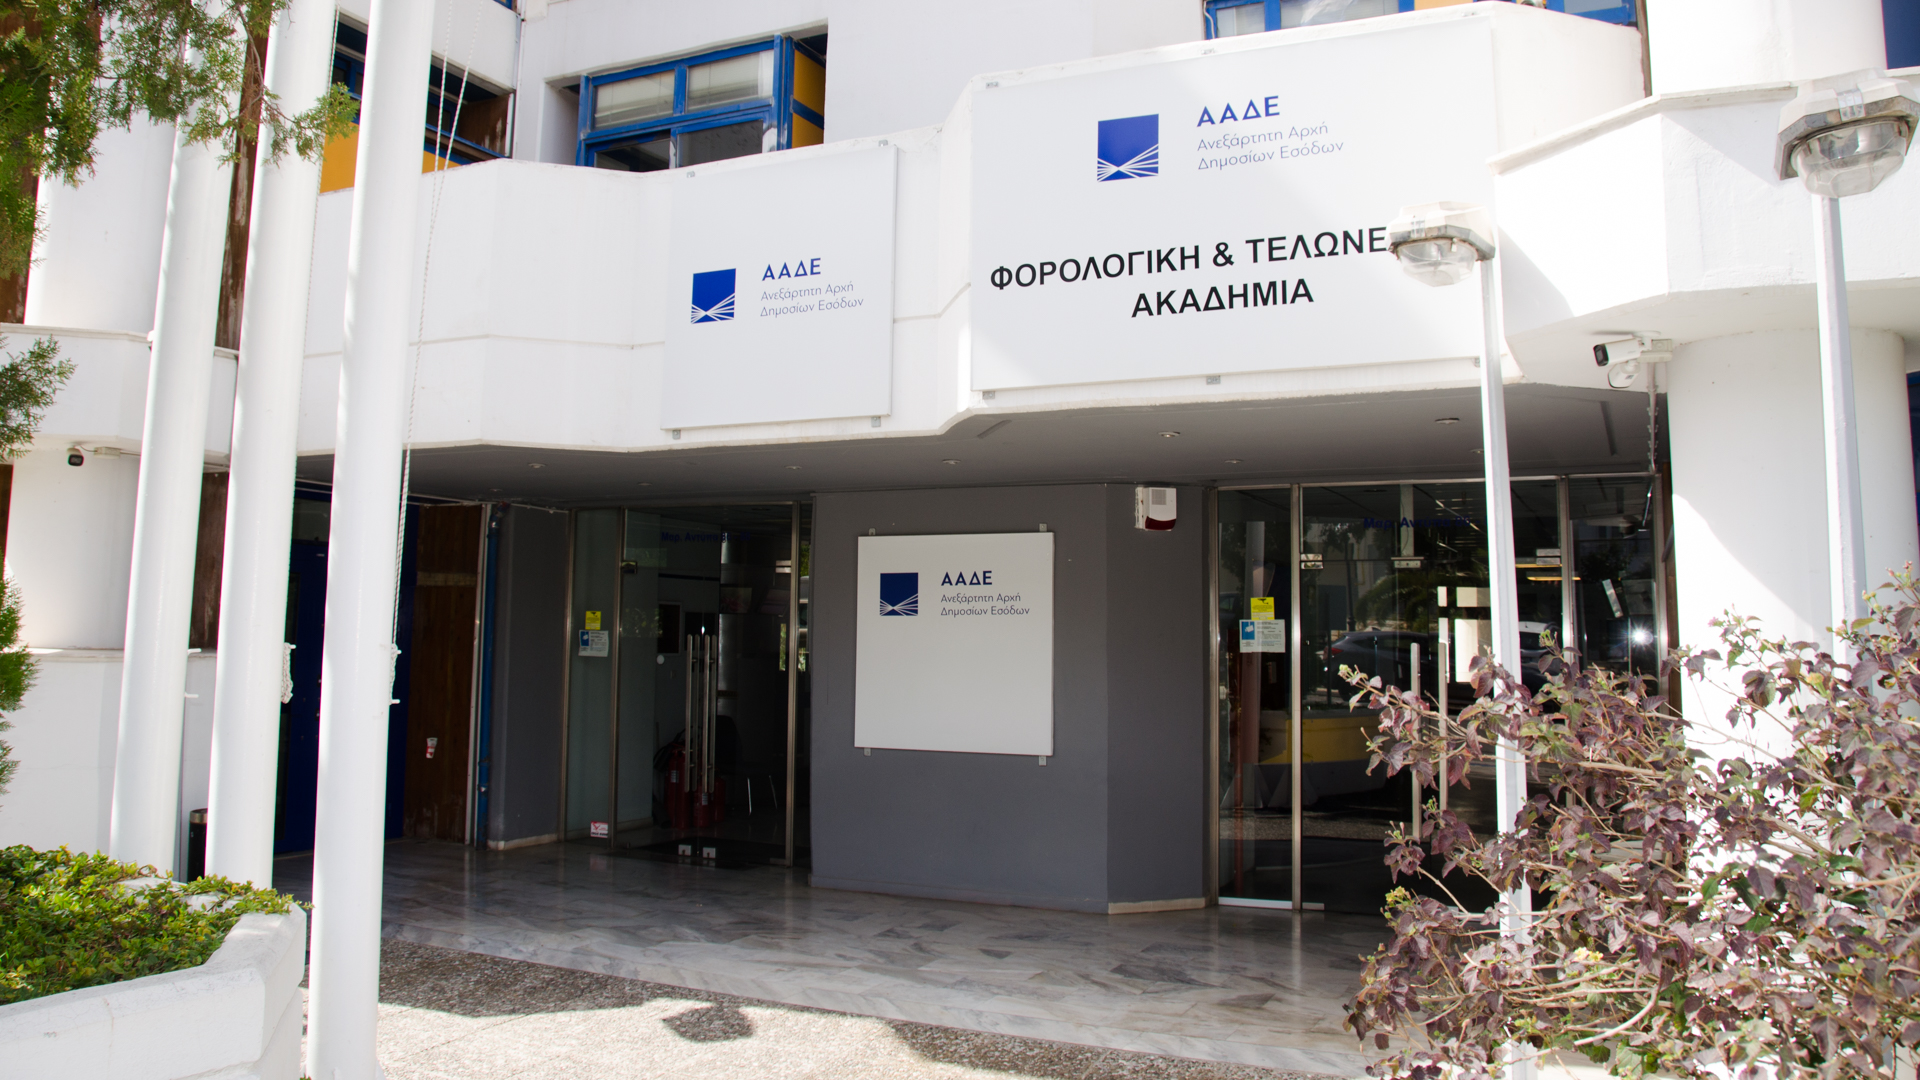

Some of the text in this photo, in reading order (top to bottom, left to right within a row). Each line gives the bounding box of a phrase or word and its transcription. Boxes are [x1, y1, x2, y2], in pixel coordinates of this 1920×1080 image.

[1197, 95, 1280, 127] ΑΑΔΕ
[1197, 121, 1329, 151] Ανεξάρτητη Αρχή
[1198, 140, 1344, 170] Δημοσίων Εσόδων
[762, 257, 821, 281] ΑΑΔΕ
[990, 226, 1388, 290] ΦΟΡΟΛΟΓΙΚΗ & ΤΕΛΩΝΕ
[760, 281, 854, 302] Ανεξάρτητη Αρχή
[1131, 278, 1314, 318] ΑΚΑΔΗΜΙΑ
[760, 296, 864, 318] Δημοσίων Εσόδων
[941, 570, 993, 586] ΑΑΔΕ
[941, 592, 1021, 604] Ανεξάρτητη Αρχή
[941, 604, 1030, 618] Δημοσίων Εσόδων
